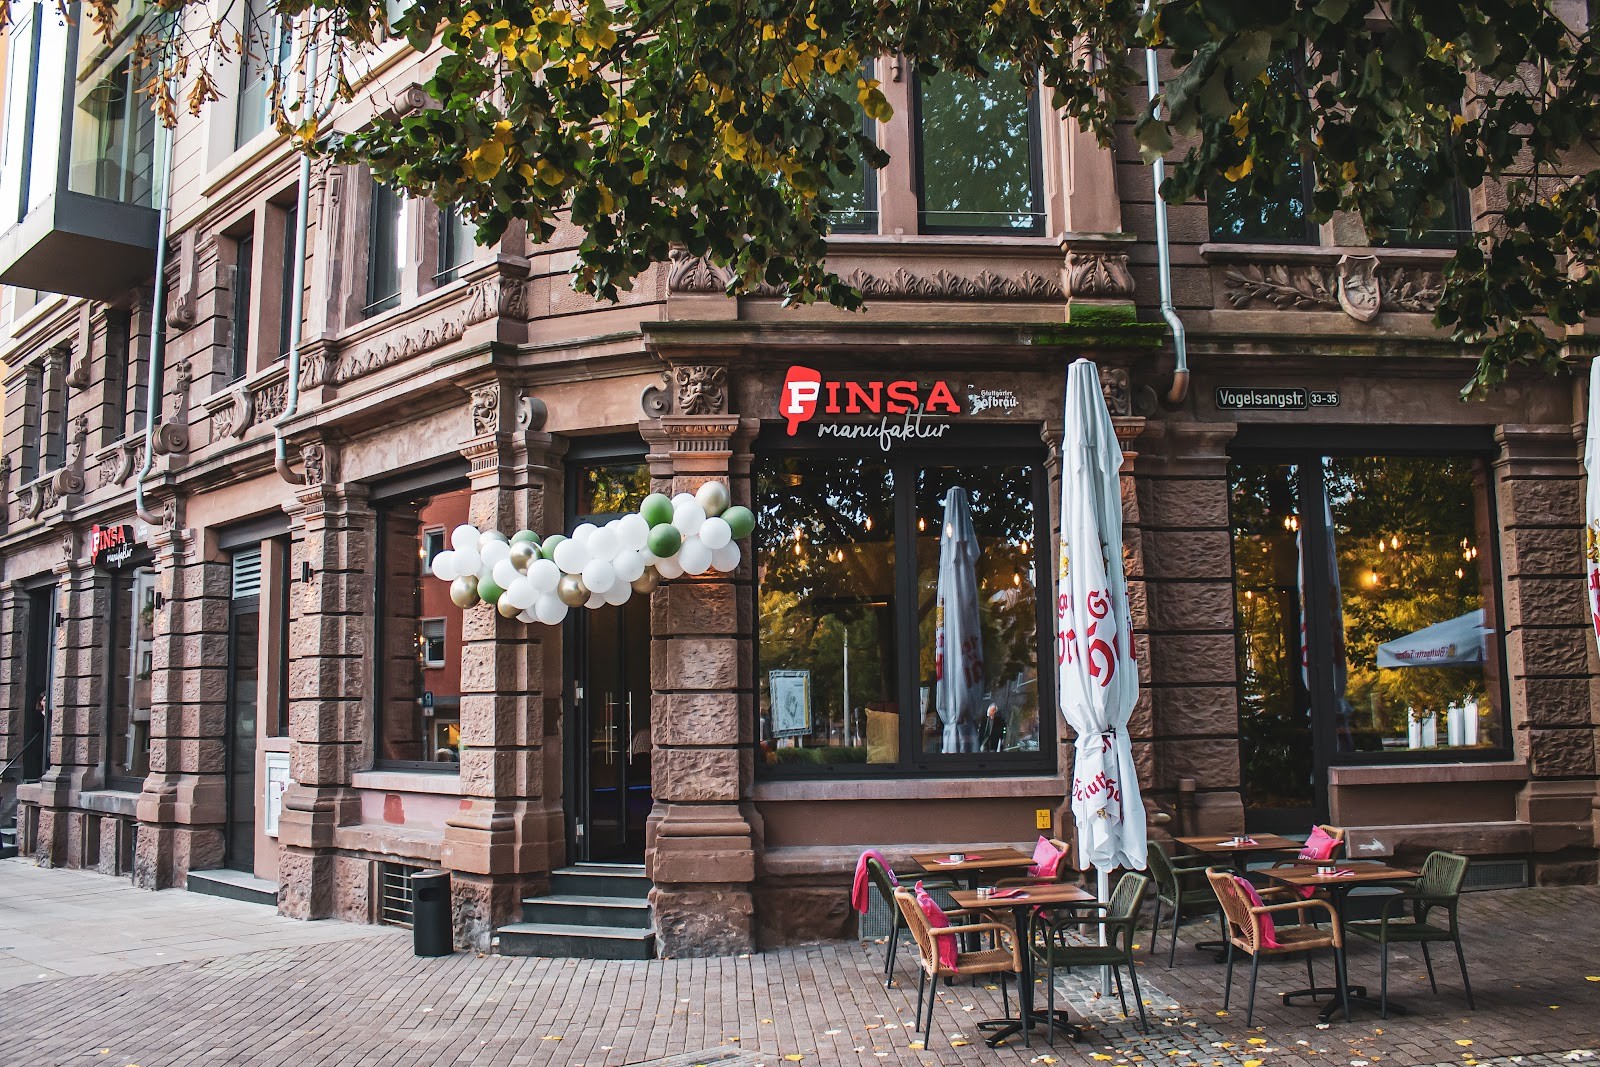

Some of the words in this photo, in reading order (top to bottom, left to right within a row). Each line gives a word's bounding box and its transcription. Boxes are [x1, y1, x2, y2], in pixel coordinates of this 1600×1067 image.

[787, 381, 960, 414] PINSA
[1220, 390, 1304, 408] Vogelsangstr.
[1311, 394, 1337, 403] 33-35
[818, 403, 950, 451] manufaktur
[93, 525, 126, 552] PINSA
